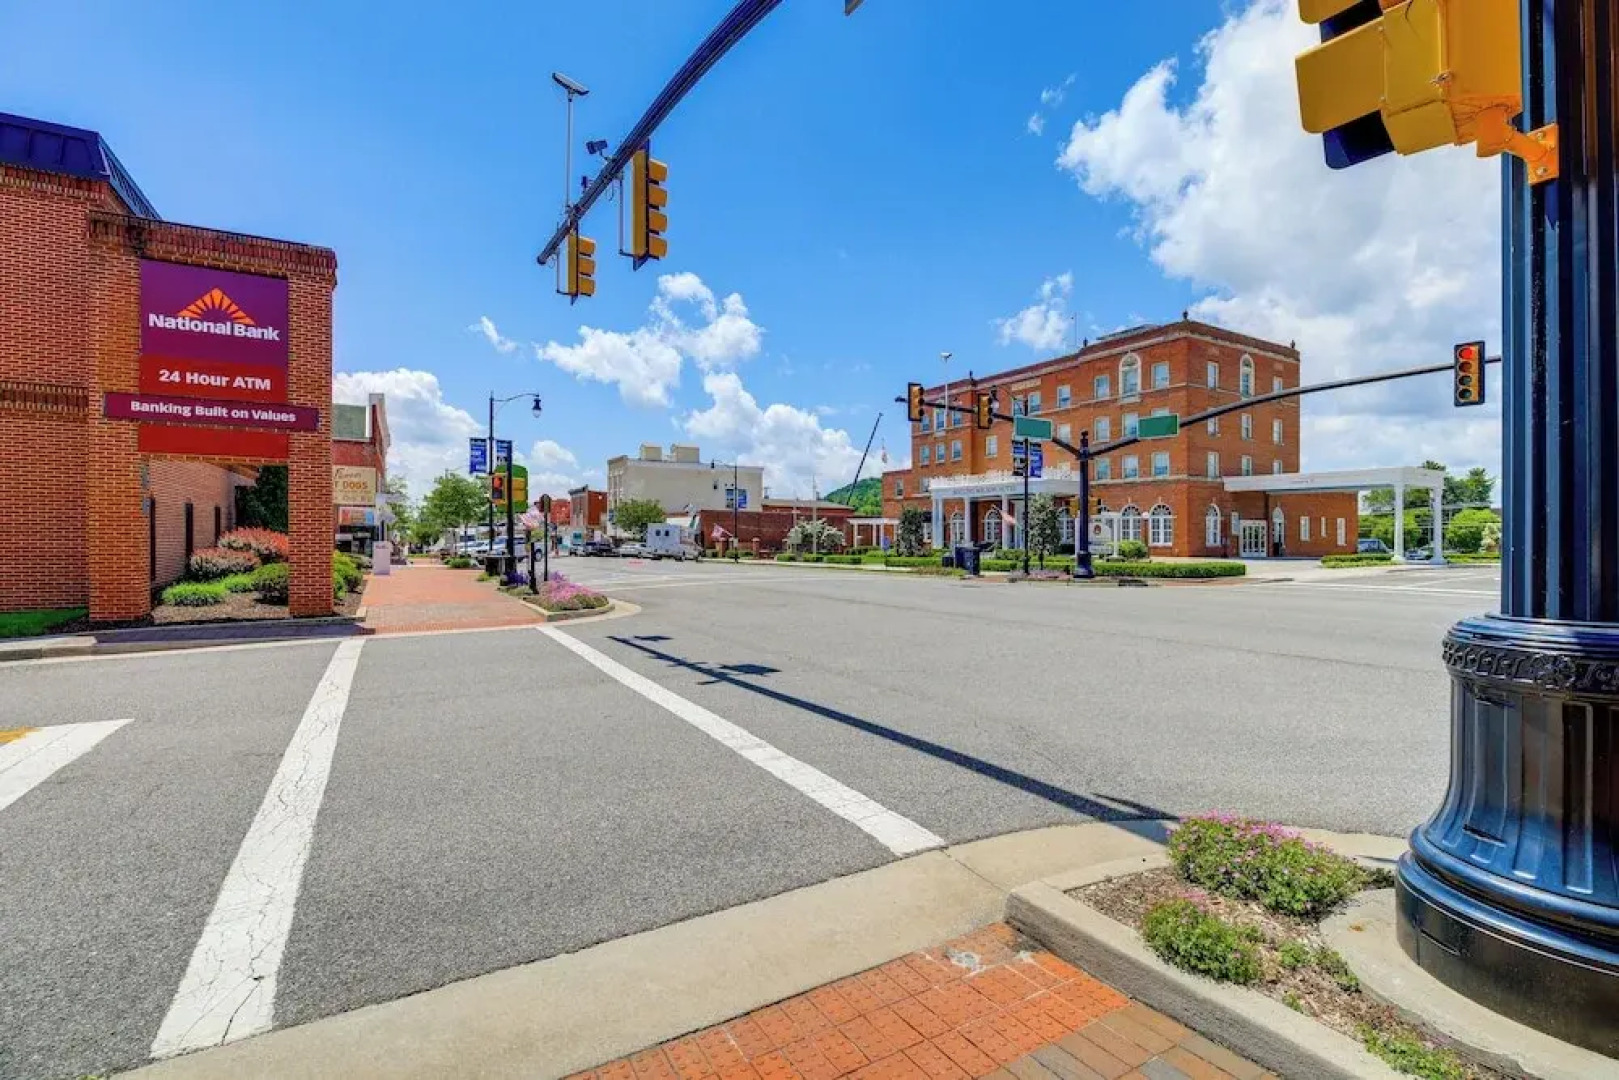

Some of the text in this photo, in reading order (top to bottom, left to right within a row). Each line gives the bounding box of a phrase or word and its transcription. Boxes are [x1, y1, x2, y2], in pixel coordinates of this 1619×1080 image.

[148, 313, 280, 341] National Bank
[158, 369, 271, 391] 24 Hour ATM
[131, 401, 297, 422] Banking Built on Values
